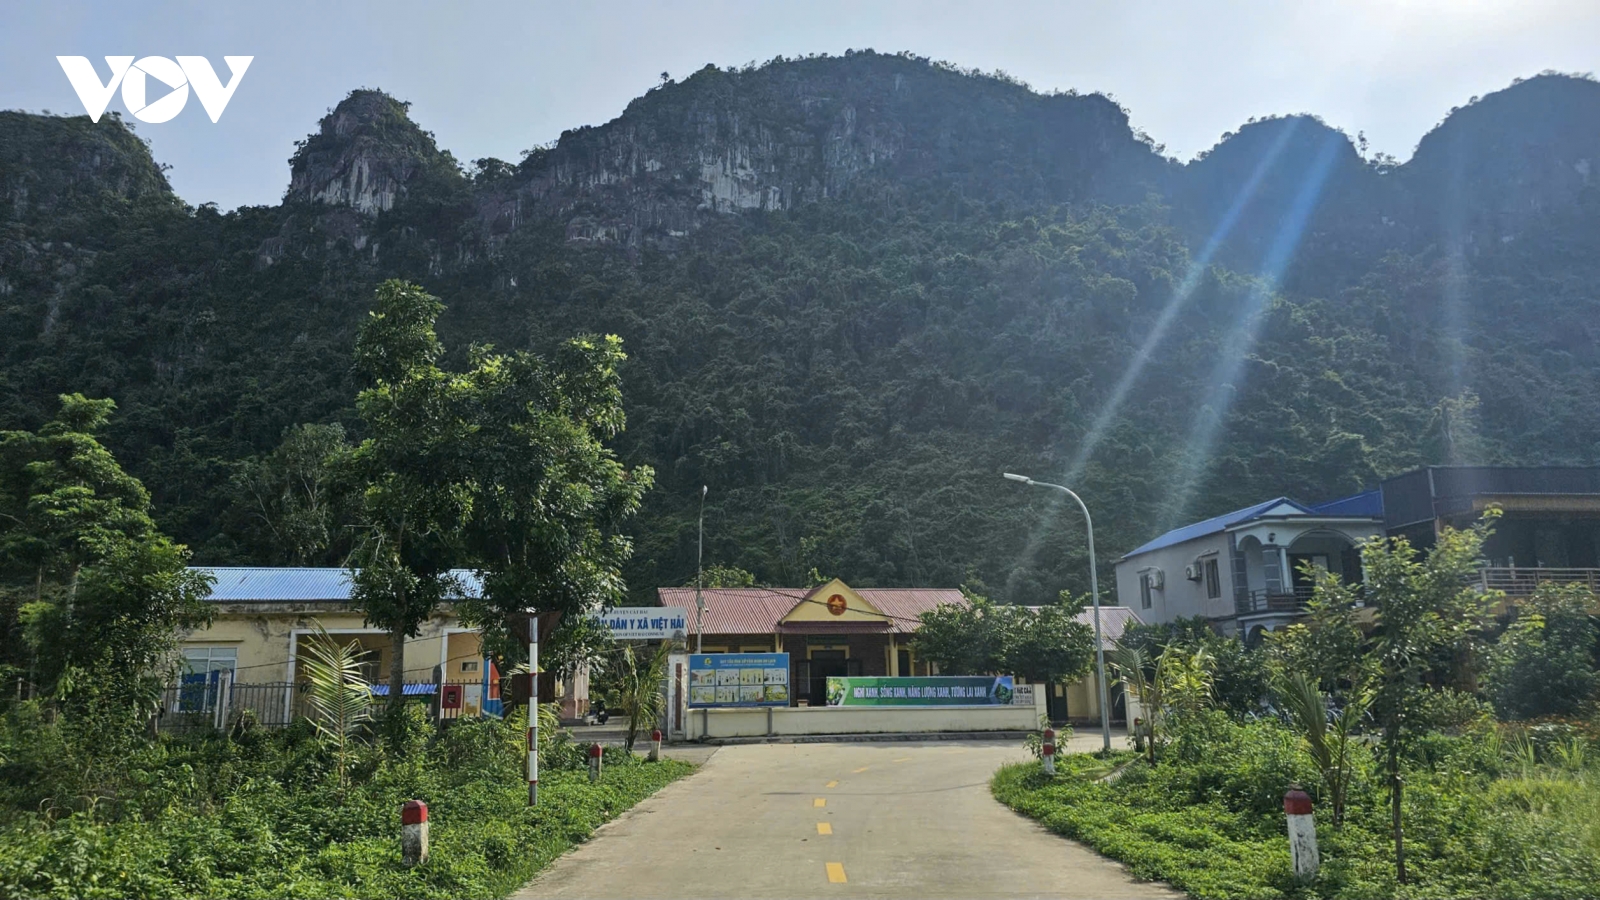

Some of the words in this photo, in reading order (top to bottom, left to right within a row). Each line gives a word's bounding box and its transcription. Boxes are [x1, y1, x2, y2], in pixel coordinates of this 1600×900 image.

[610, 616, 627, 629] DÂN
[629, 619, 635, 629] Y
[637, 616, 648, 629] XÃ
[651, 616, 668, 631] VIỆT
[670, 615, 684, 629] HẢI
[880, 684, 893, 698] SỐNG
[893, 687, 907, 699] XANH,
[907, 685, 920, 698] NĂNG
[921, 686, 936, 700] LƯỢNG
[937, 686, 951, 698] XANH,
[974, 687, 986, 697] XANH
